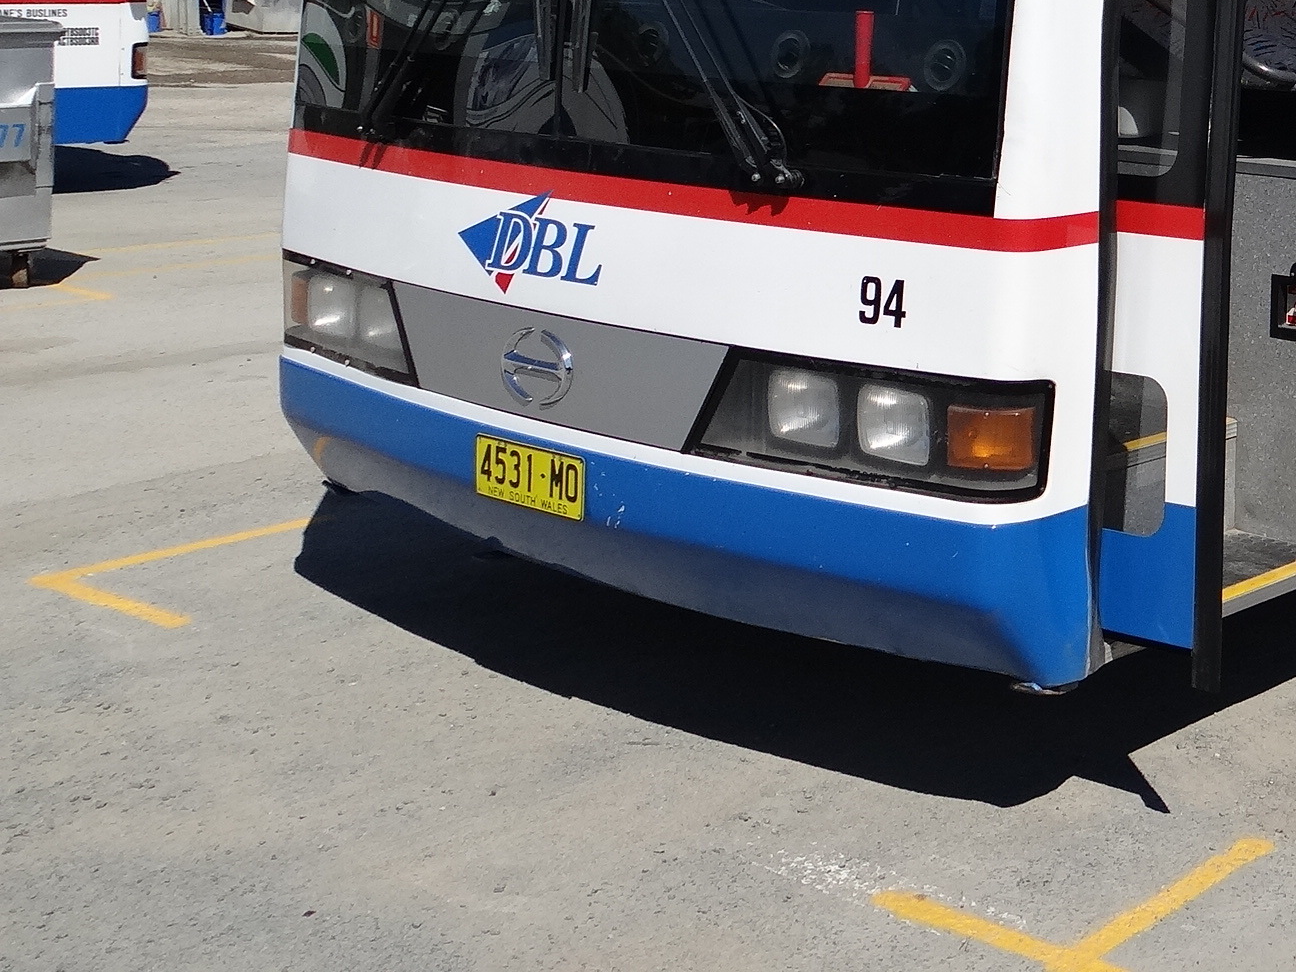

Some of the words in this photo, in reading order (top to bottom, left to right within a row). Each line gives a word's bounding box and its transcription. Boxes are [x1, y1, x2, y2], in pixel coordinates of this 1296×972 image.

[26, 9, 67, 17] BUSLINES
[487, 211, 602, 286] DBL
[859, 276, 906, 328] 94
[488, 486, 505, 498] NEW
[509, 491, 536, 506] SOUTH
[541, 499, 568, 515] WALES
